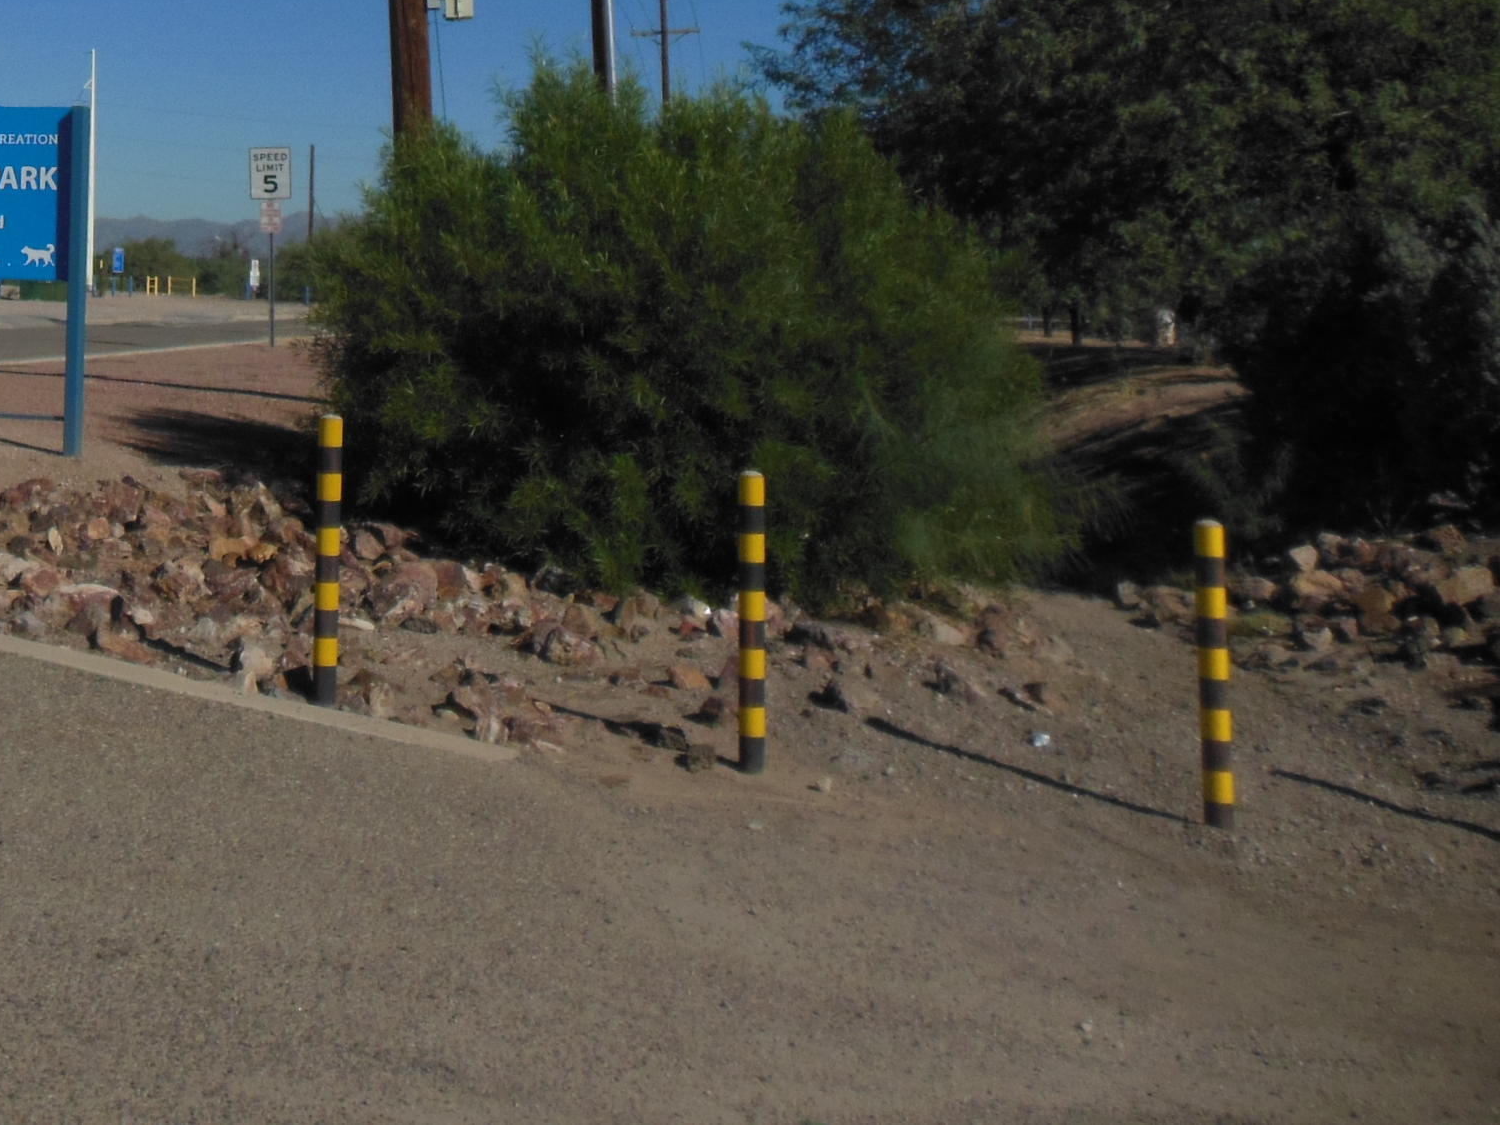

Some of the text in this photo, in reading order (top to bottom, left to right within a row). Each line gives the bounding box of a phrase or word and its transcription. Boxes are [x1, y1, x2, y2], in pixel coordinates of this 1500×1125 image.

[253, 153, 287, 161] SPEED
[256, 163, 284, 172] LIMIT
[263, 175, 278, 193] 5
